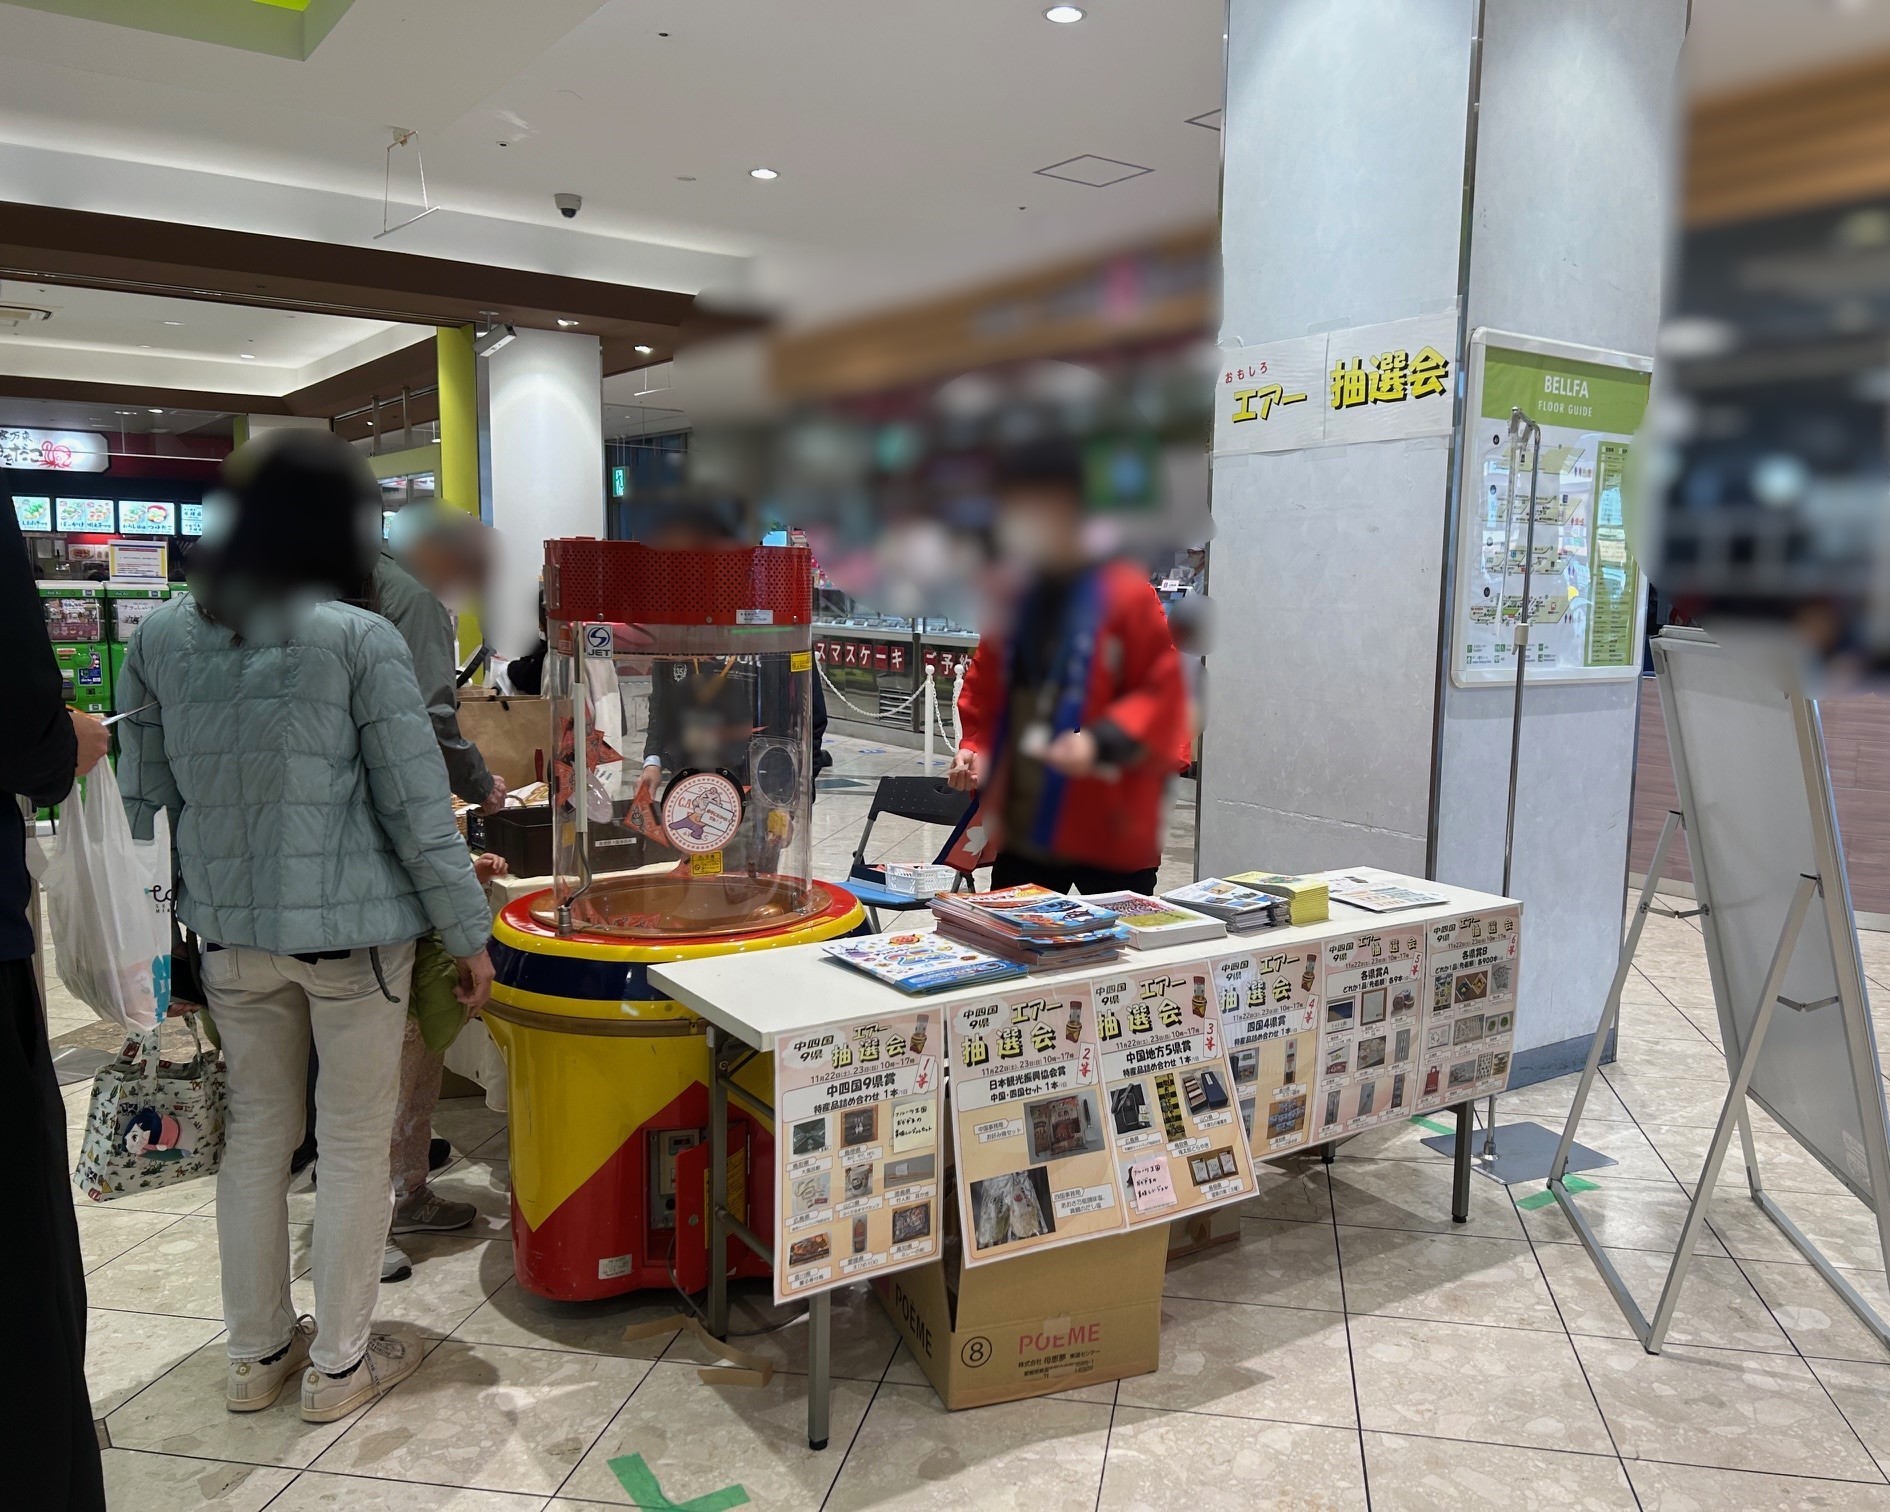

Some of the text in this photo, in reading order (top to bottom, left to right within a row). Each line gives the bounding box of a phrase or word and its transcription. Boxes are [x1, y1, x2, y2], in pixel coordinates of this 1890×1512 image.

[1225, 361, 1269, 384] おもしろ
[1232, 345, 1450, 423] エアー 抽選会
[1544, 375, 1589, 398] BELLFA
[1538, 400, 1592, 417] FLOOR GUIDE
[588, 649, 610, 657] JET
[1434, 924, 1456, 934] 中四国
[1329, 942, 1354, 953] 中四国
[1462, 947, 1488, 960] 各県賞B
[1222, 960, 1249, 972] 中四国
[1260, 952, 1300, 975] エアー
[1361, 966, 1389, 980] 各県賞A
[1226, 972, 1241, 981] 9県
[1096, 982, 1126, 996] 中四国
[1139, 975, 1186, 1000] エアー
[1220, 975, 1292, 1014] 抽選会
[1101, 995, 1120, 1005] 9県
[963, 1005, 998, 1019] 中四国
[1011, 998, 1063, 1024] エアー
[1097, 998, 1182, 1042] 抽選会
[852, 1022, 892, 1041] エアー
[969, 1018, 990, 1029] 9県
[1248, 1015, 1286, 1032] 四国4県賞
[794, 1035, 834, 1051] 中四国
[832, 1033, 906, 1069] 抽選会
[961, 1021, 1056, 1067] 抽選会
[1126, 1040, 1192, 1065] 中国地方5県賞
[800, 1049, 823, 1062] 9県
[1122, 1058, 1176, 1078] 特産品詰め合わせ
[826, 1072, 896, 1098] 中四国9県賞
[990, 1066, 1066, 1091] 日本観光振興協会賞
[814, 1092, 879, 1115] 特産品詰め合わせ
